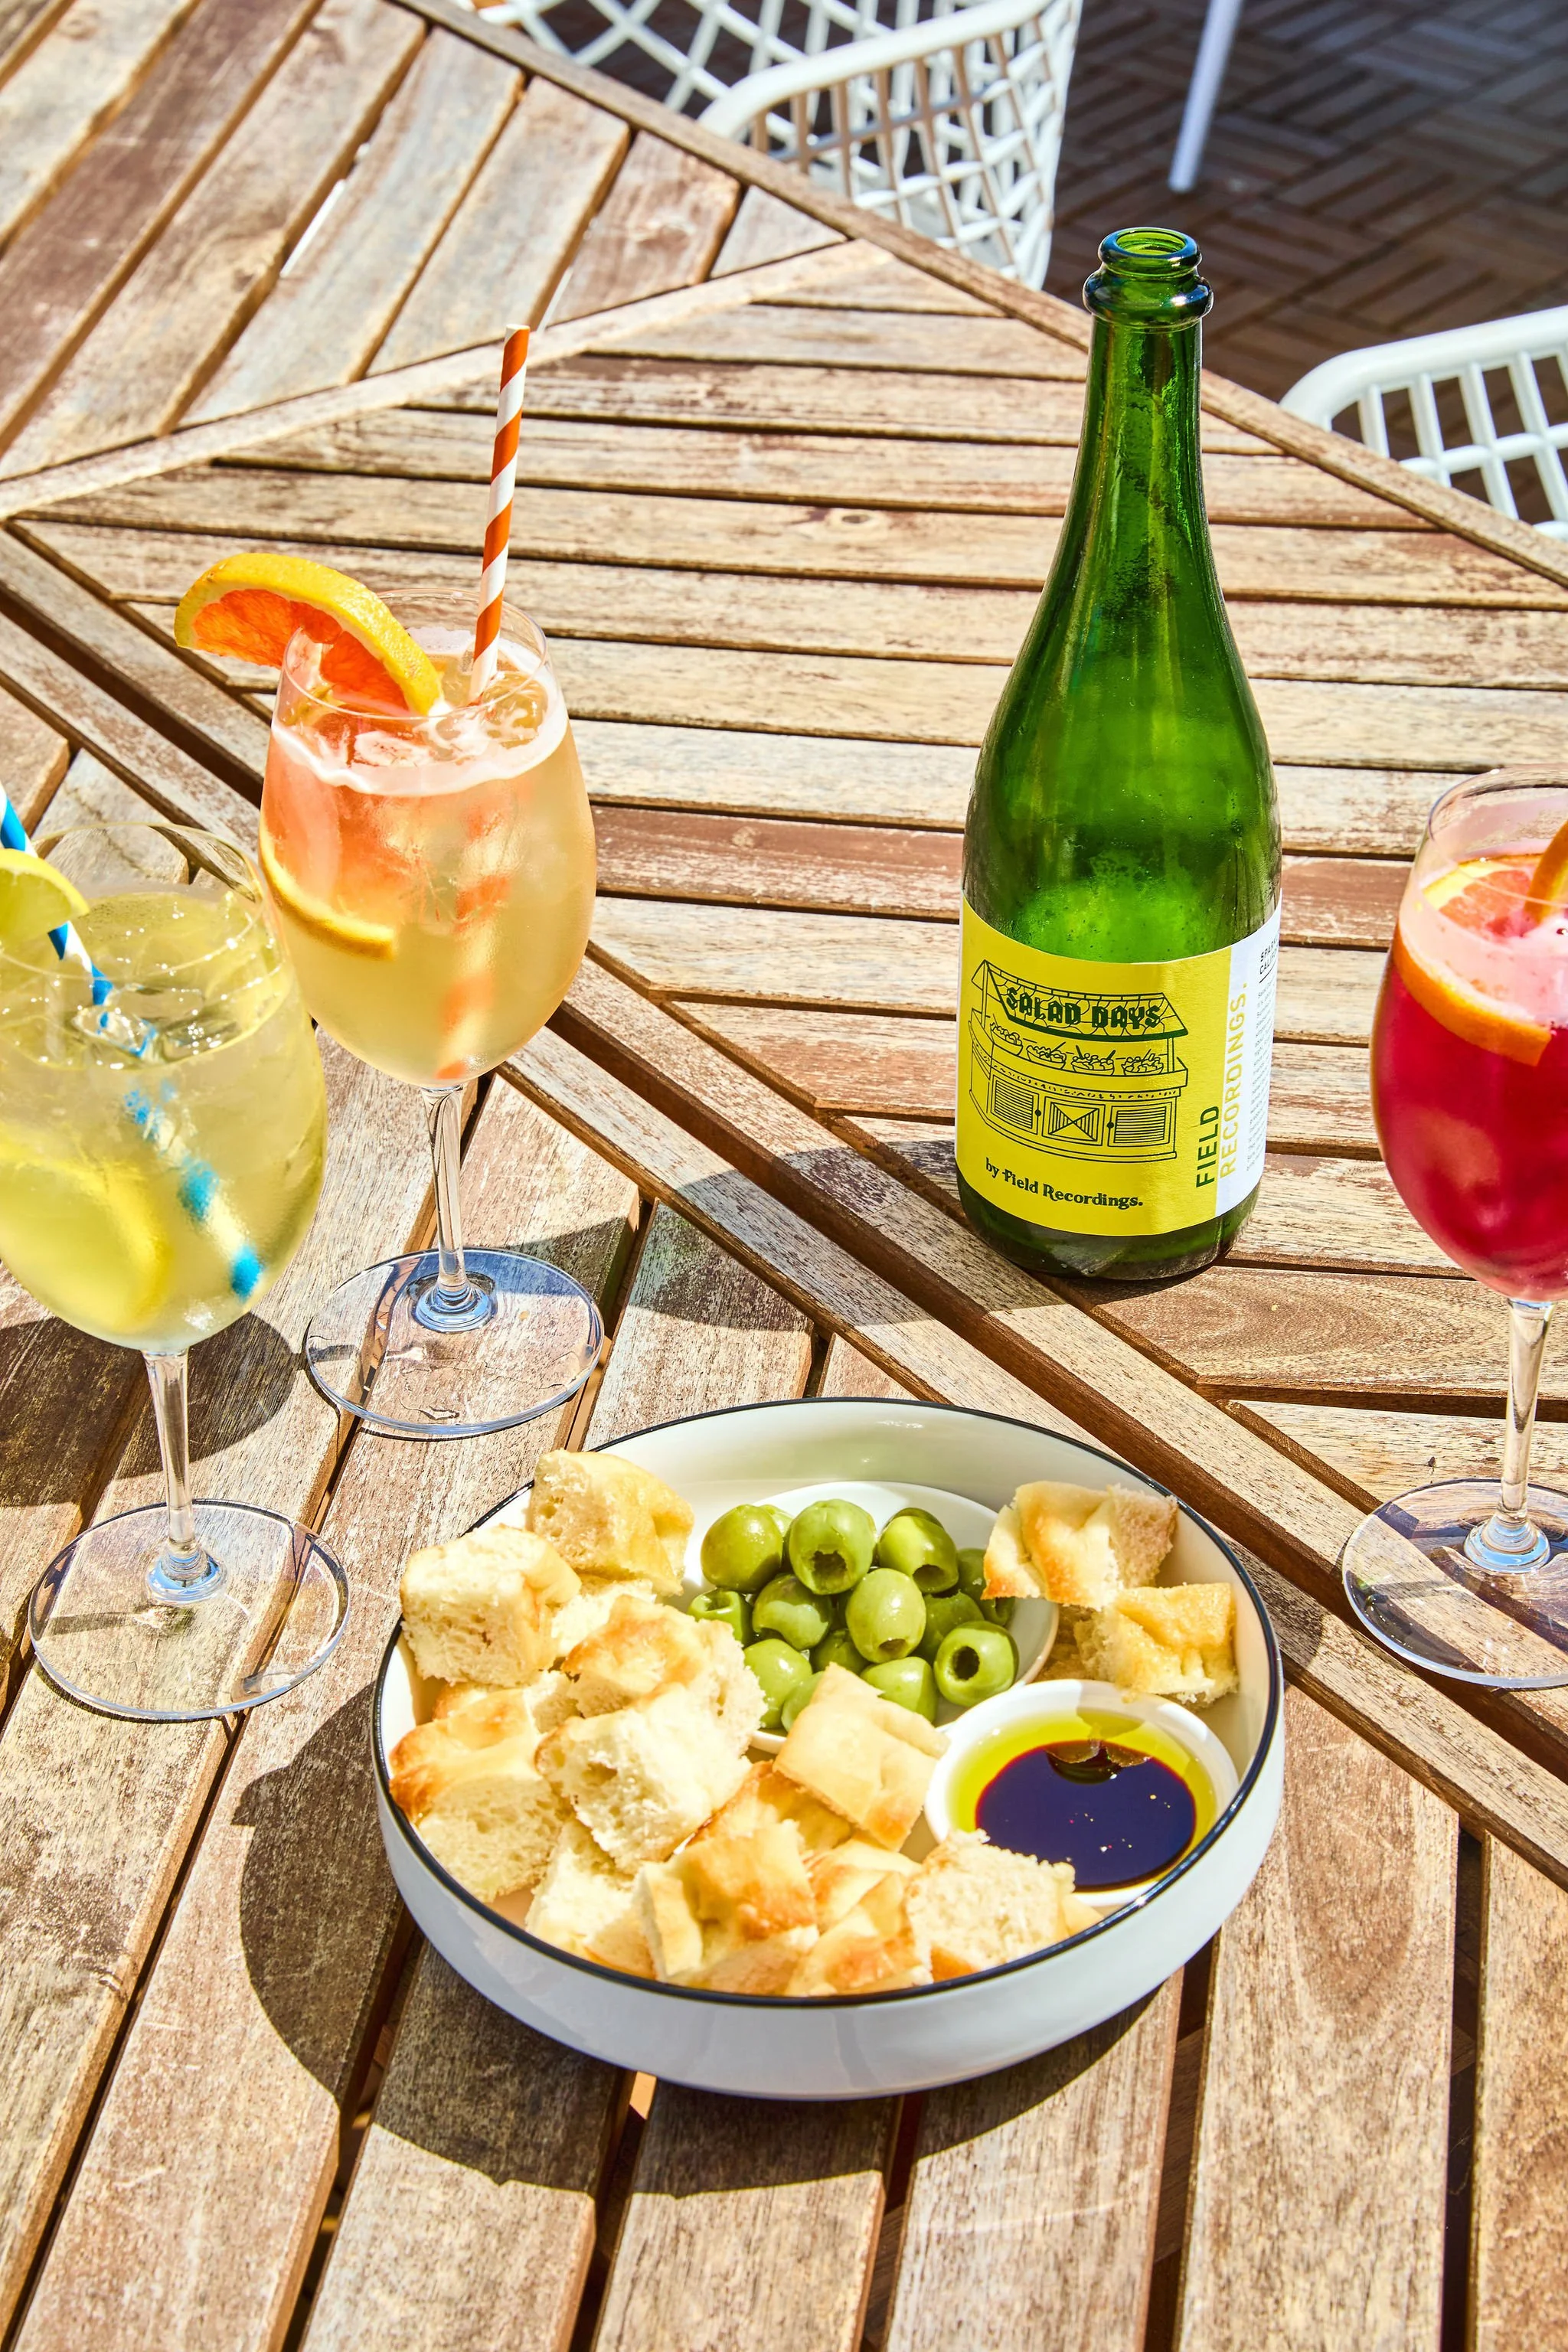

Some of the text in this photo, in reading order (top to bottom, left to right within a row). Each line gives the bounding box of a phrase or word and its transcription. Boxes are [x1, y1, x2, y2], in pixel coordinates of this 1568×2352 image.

[1006, 987, 1160, 1029] SALAD DAYS
[1219, 982, 1248, 1178] RECORDINGS.
[1196, 1106, 1220, 1187] FIELD
[985, 1157, 1144, 1210] by Field Recordings.
